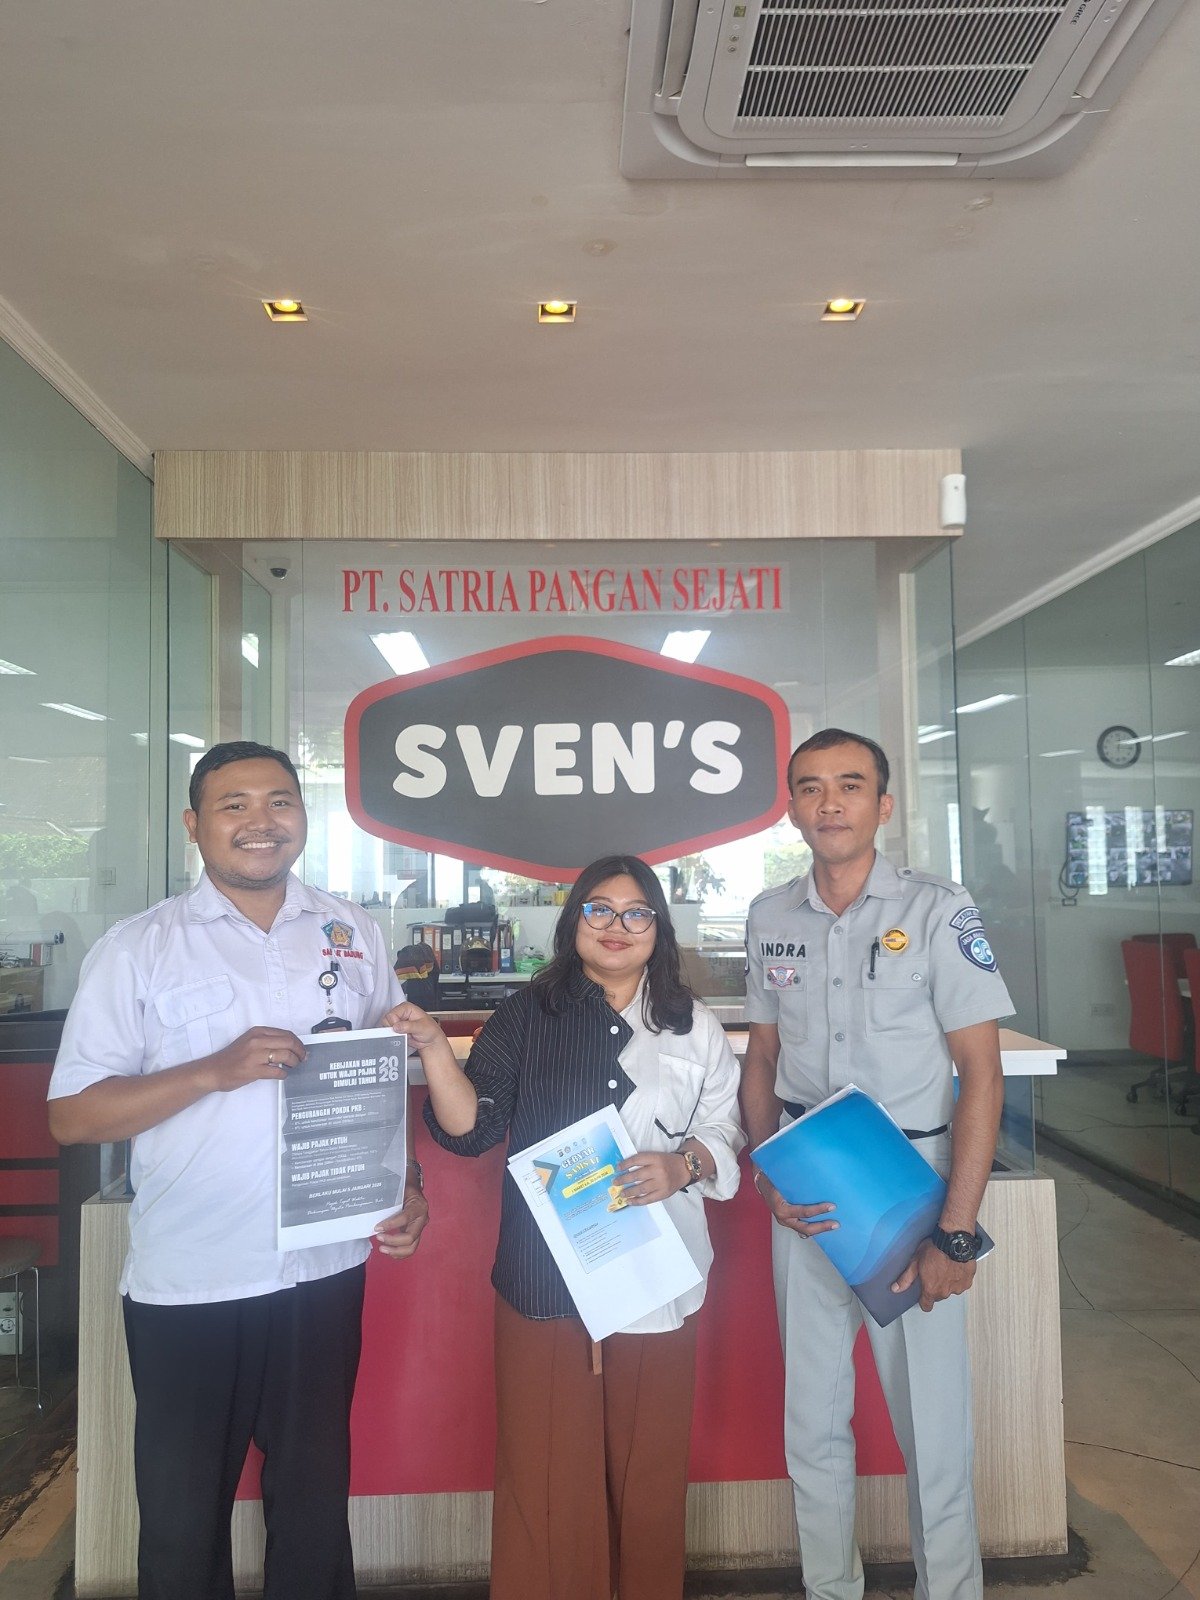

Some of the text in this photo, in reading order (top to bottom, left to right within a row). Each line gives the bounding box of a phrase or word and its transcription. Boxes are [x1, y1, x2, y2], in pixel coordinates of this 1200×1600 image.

[342, 567, 783, 613] PT. SATRIA PANGAN SEJATI
[393, 720, 744, 798] SVEN'S
[761, 942, 806, 958] INDRA
[329, 1058, 376, 1070] KEBIJAKAN BARU
[379, 1055, 399, 1069] 20
[319, 1067, 376, 1080] UNTUK WAJIB PAJAK
[379, 1068, 399, 1082] 26
[333, 1076, 377, 1088] DIMULAI TAHUN
[291, 1108, 331, 1120] PENGURANGAN
[332, 1106, 350, 1115] POKOK
[291, 1136, 348, 1151] WAJIB PAJAK PATUH
[291, 1163, 365, 1182] WAJIB PAJAK TIDAK PATUH
